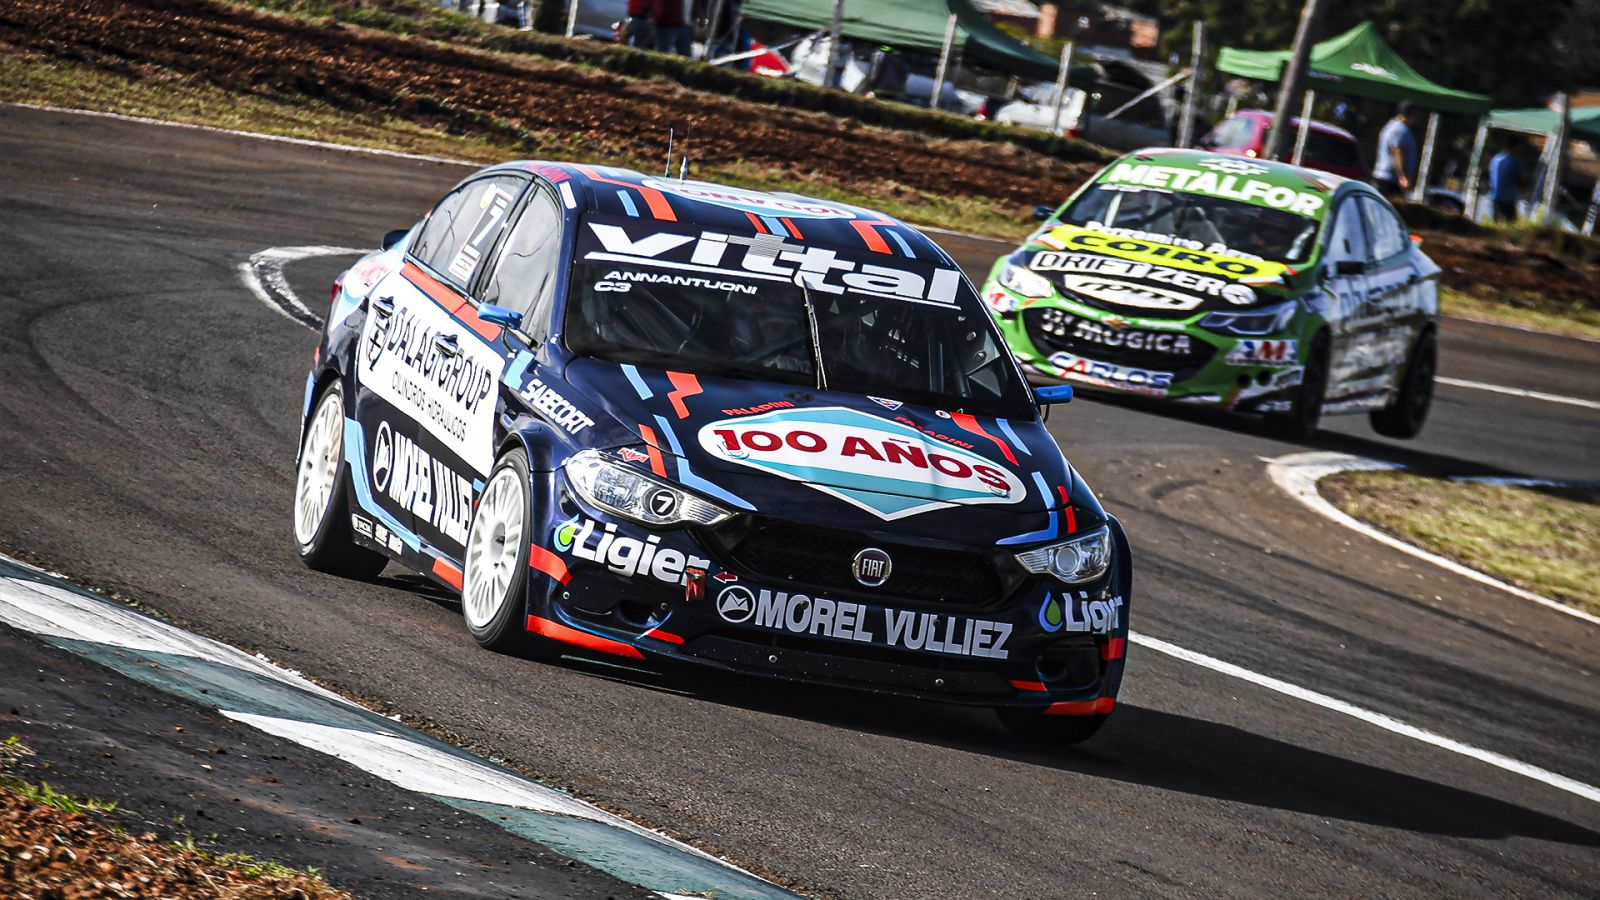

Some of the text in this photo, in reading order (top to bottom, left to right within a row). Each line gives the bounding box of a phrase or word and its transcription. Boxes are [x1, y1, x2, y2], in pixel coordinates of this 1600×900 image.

[1108, 163, 1324, 216] METALFOR
[1071, 235, 1258, 275] COIRO
[594, 281, 632, 294] C3
[603, 271, 758, 296] ANNANTUONI
[520, 378, 595, 435] SABECORT
[721, 400, 795, 416] PALADINI
[895, 416, 974, 449] PALADINI
[713, 429, 1011, 492] 100 AÑOS
[656, 495, 674, 513] 7
[571, 519, 711, 587] Ligier
[861, 557, 886, 577] FIAT
[754, 589, 1014, 660] MOREL VULLIEZ
